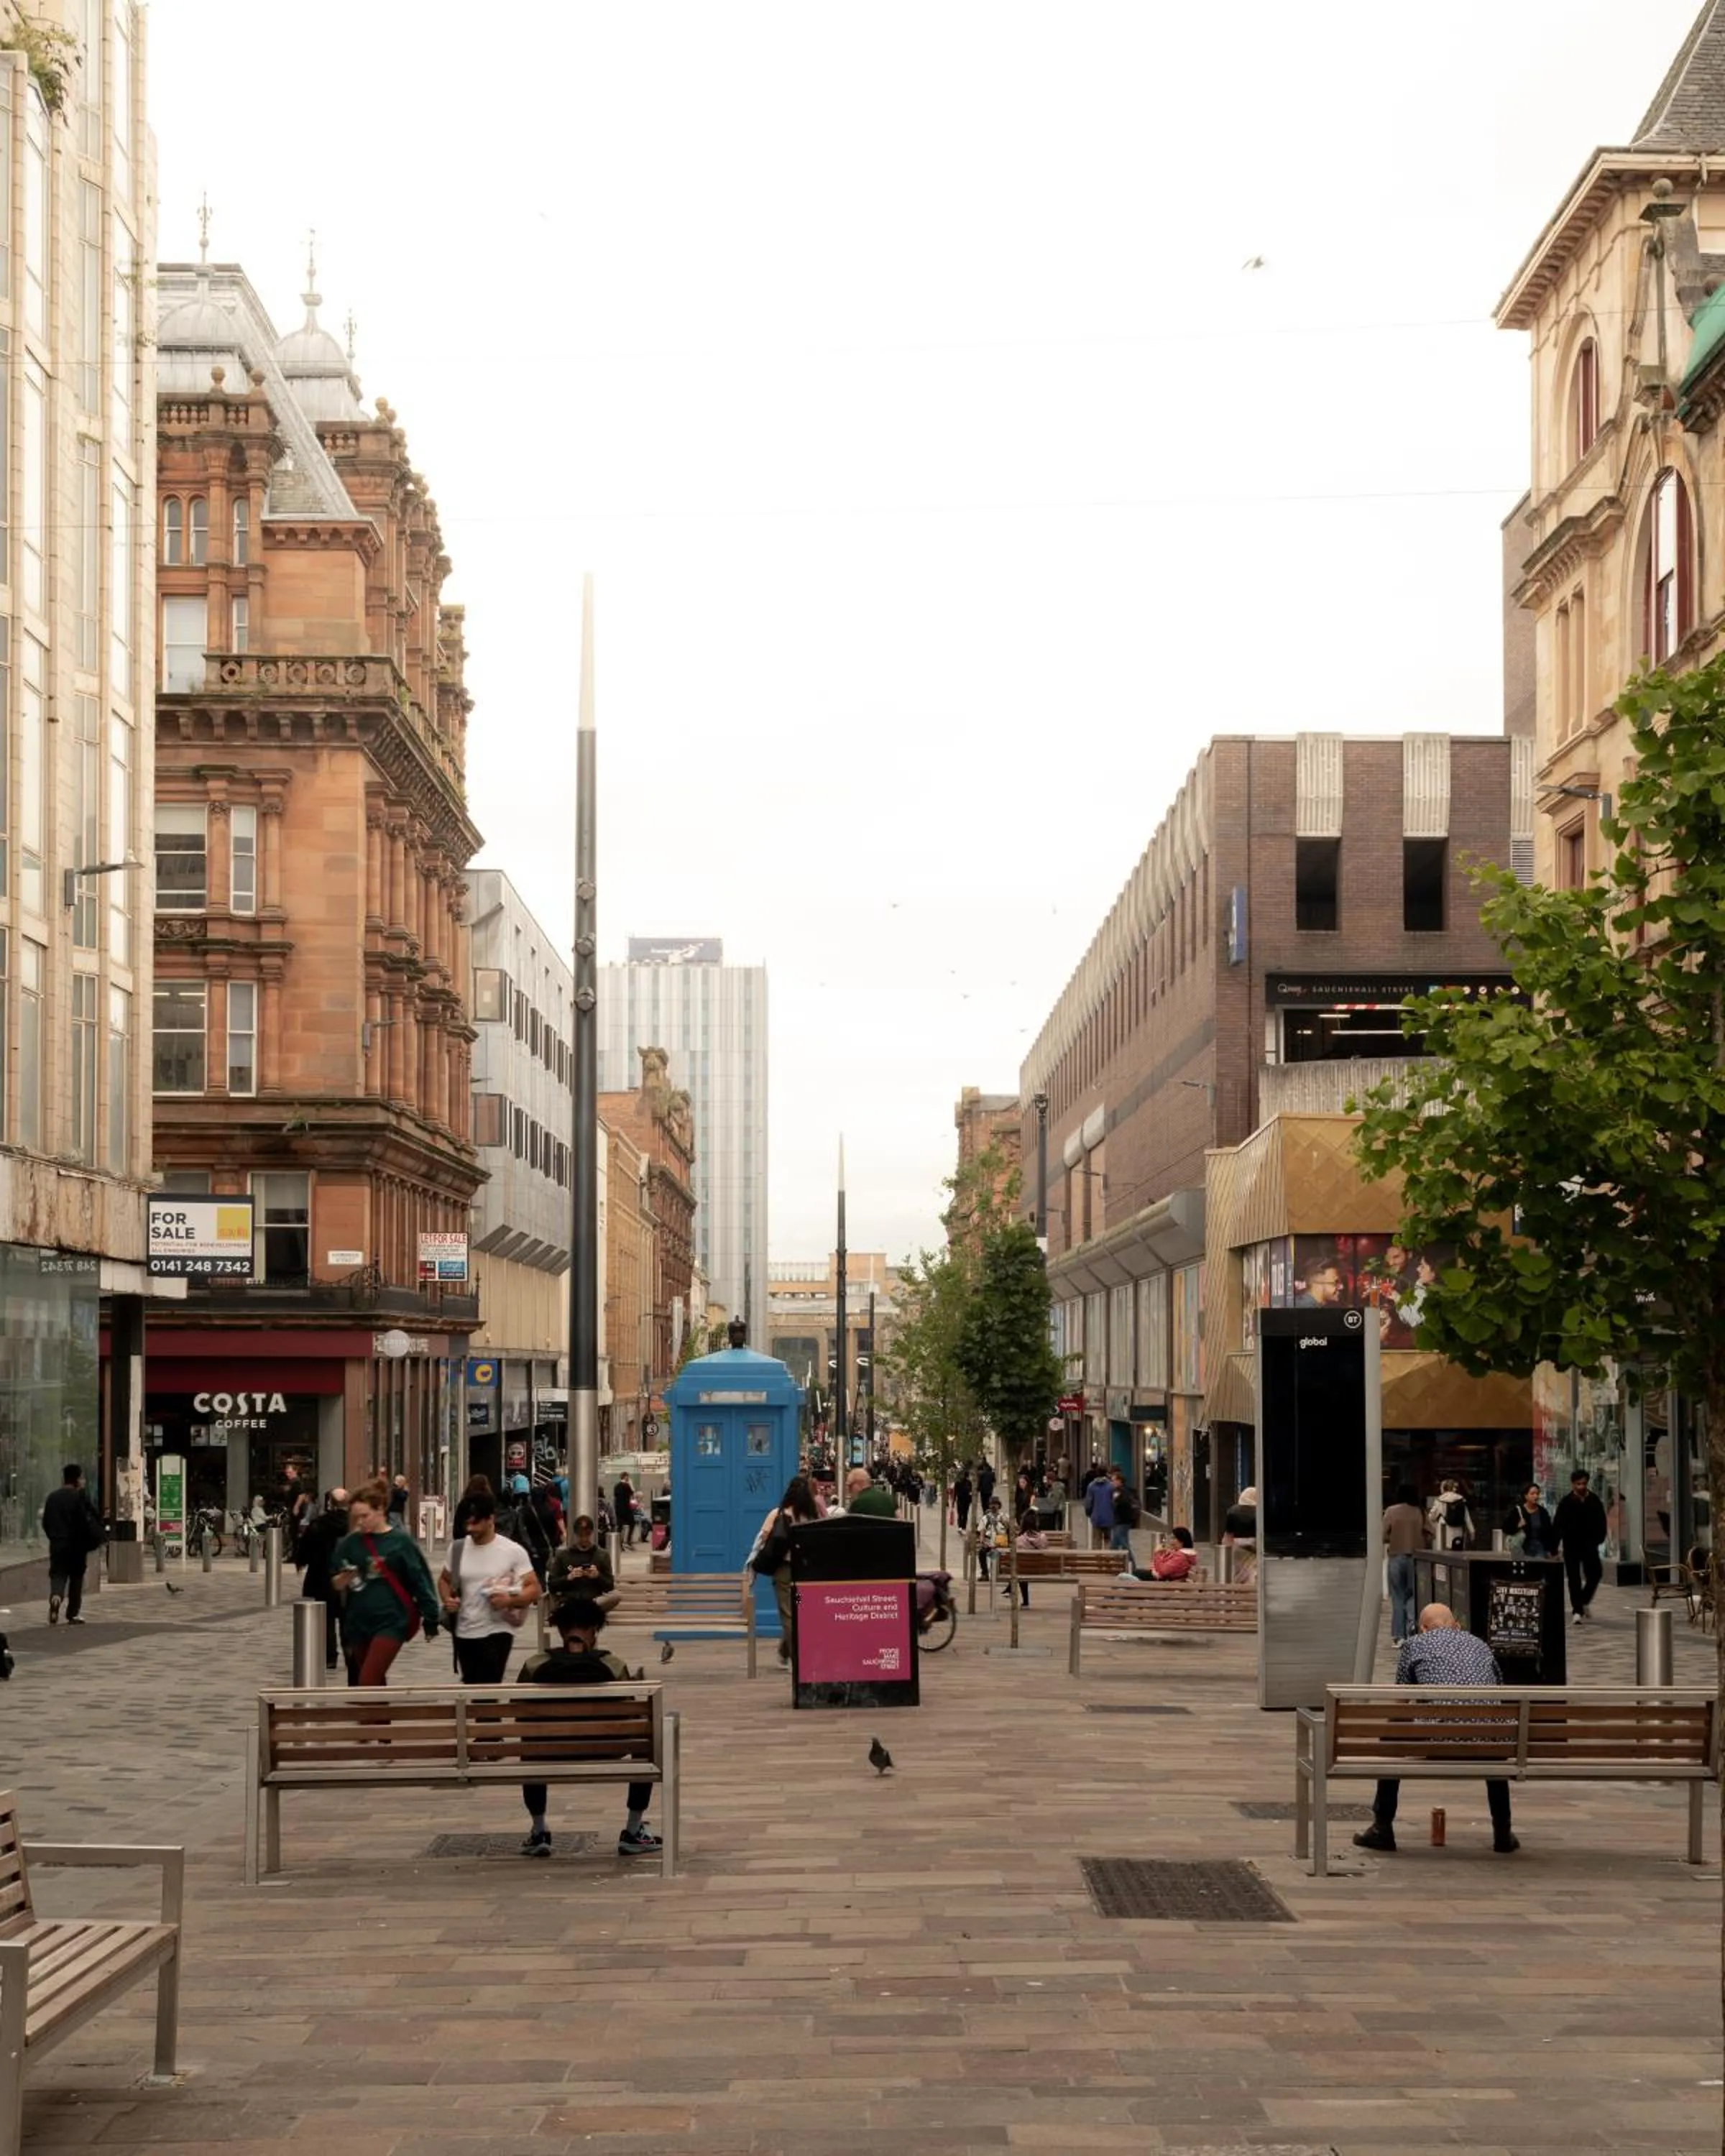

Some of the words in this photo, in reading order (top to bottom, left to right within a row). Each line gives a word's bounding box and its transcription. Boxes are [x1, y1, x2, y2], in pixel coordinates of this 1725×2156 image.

[151, 1212, 187, 1225] FOR
[151, 1226, 196, 1240] SALE
[450, 1233, 466, 1243] SALE
[150, 1259, 182, 1271] 0141
[185, 1261, 212, 1272] 248
[216, 1261, 251, 1273] 7342
[1299, 1336, 1328, 1349] global
[193, 1392, 288, 1416] COSTA
[215, 1419, 267, 1429] COFFEE
[824, 1595, 870, 1604] Sauchiehall
[852, 1603, 881, 1612] Culture
[834, 1613, 869, 1621] Heritage
